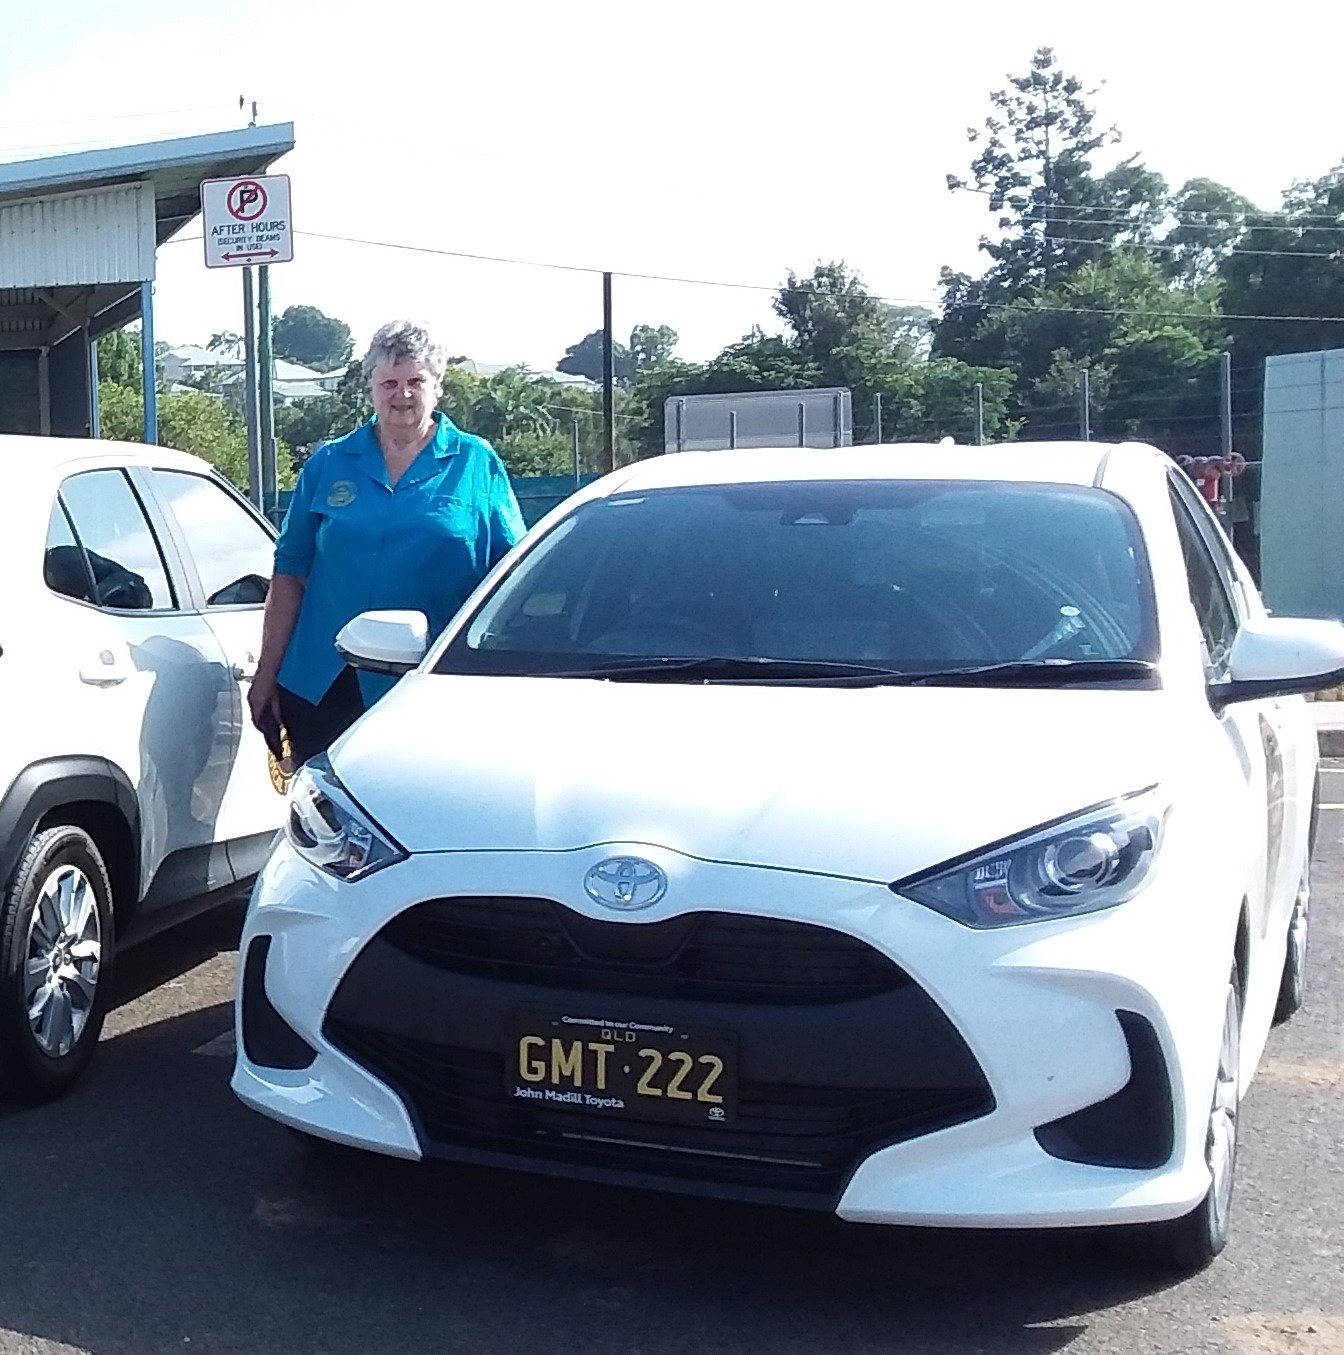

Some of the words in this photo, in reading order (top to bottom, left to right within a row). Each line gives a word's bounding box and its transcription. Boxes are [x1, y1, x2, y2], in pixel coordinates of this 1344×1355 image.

[211, 224, 245, 236] AFTER
[251, 220, 286, 233] HOURS
[601, 1029, 636, 1042] QLD
[514, 1086, 543, 1100] John
[544, 1089, 583, 1105] Madill
[584, 1094, 625, 1109] Toyota
